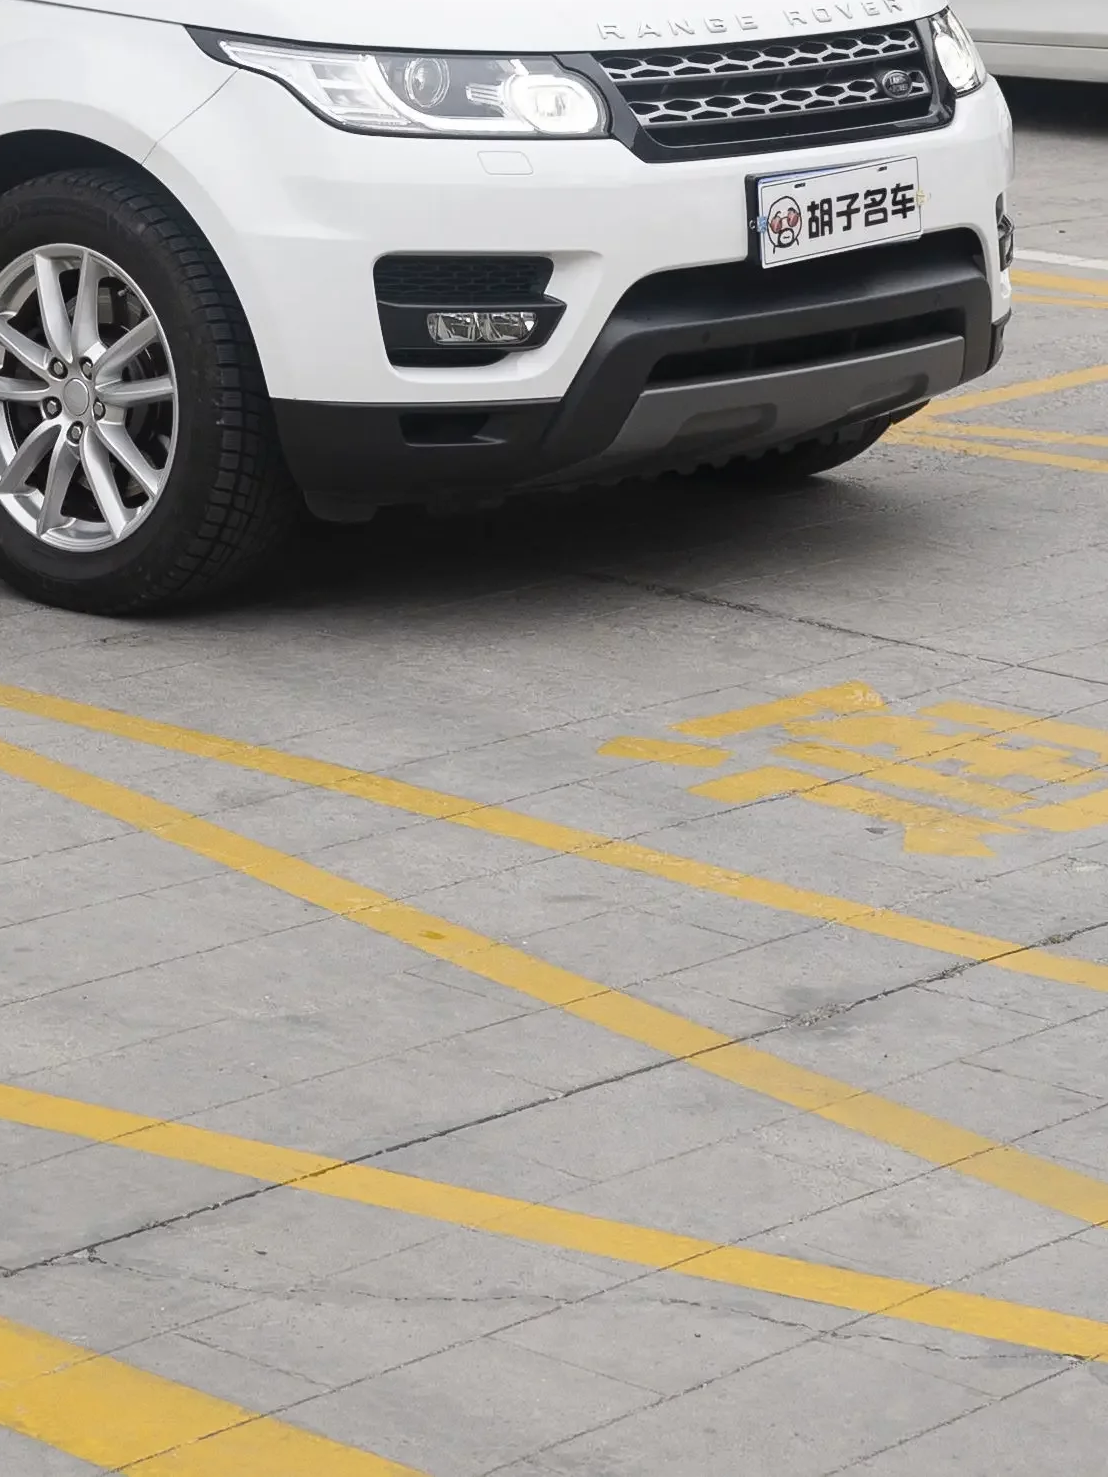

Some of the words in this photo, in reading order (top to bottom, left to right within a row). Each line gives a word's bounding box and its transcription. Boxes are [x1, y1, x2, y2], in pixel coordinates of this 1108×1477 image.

[596, 13, 759, 40] RANGE
[806, 182, 915, 239] 胡子名车
